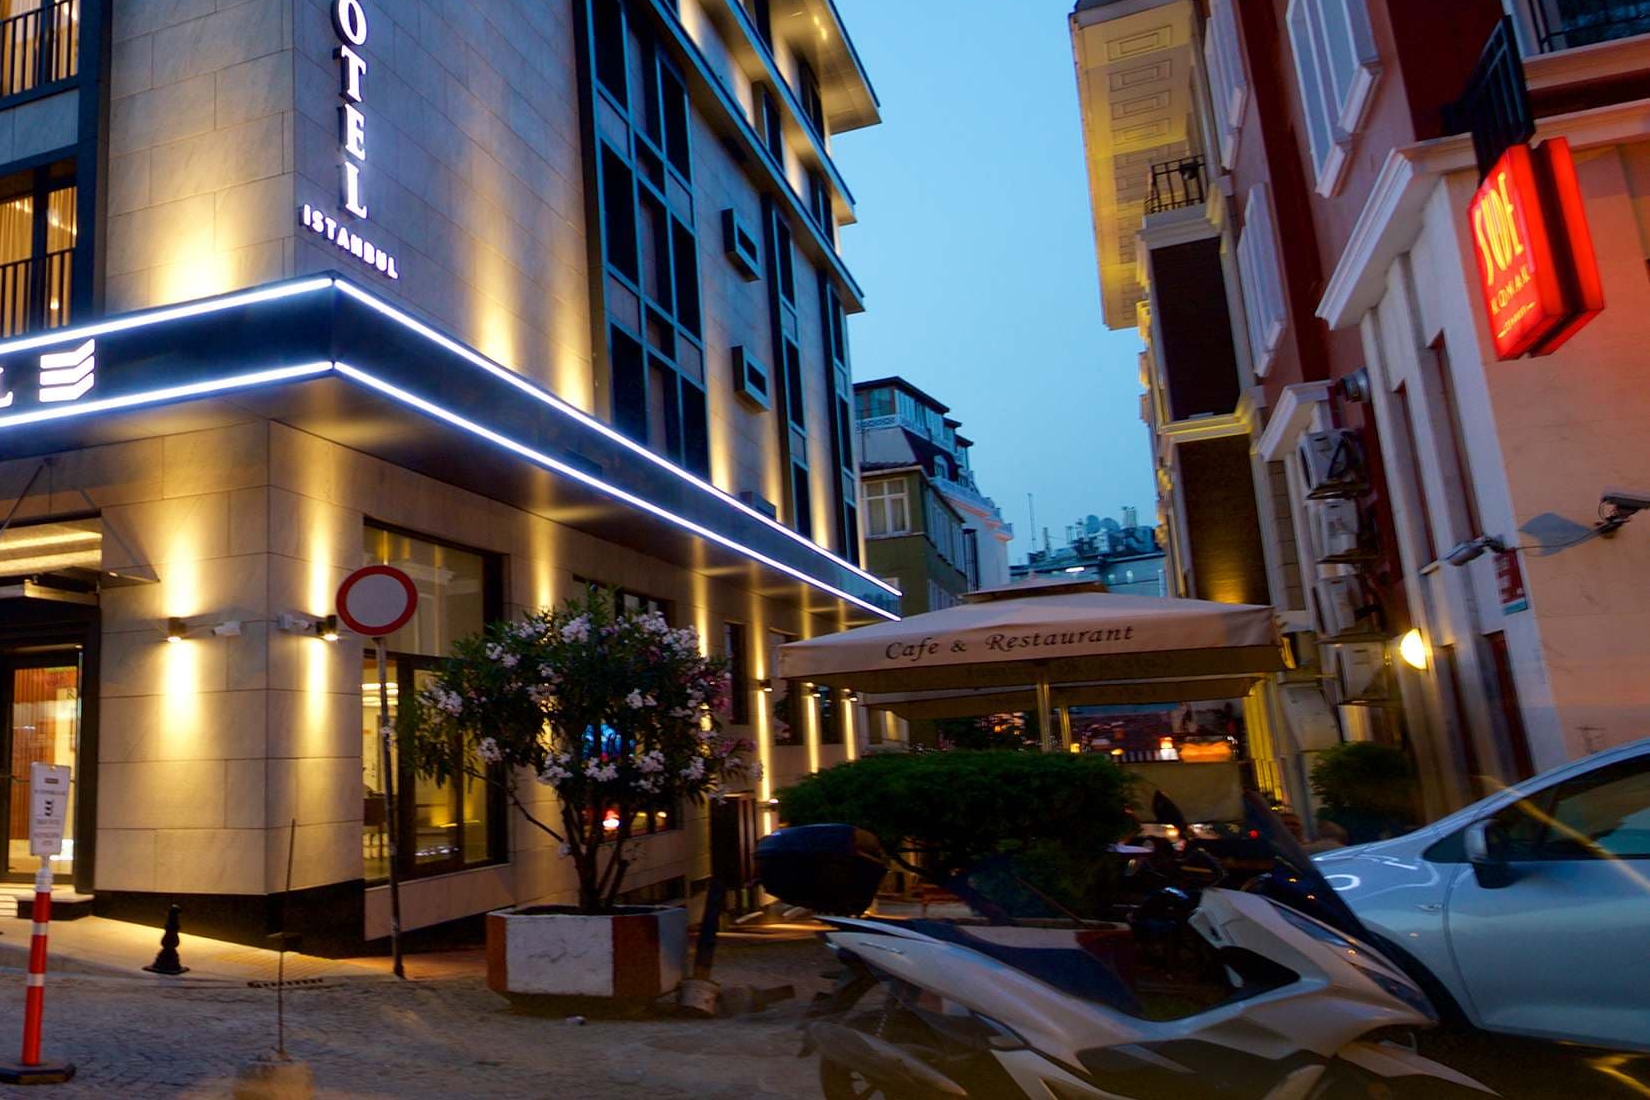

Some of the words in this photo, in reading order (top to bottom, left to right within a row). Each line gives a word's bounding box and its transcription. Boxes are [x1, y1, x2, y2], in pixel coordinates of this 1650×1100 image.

[303, 204, 399, 279] ISTANBUL
[1490, 264, 1531, 316] KONAK
[885, 636, 939, 661] Cafe
[950, 639, 966, 652] &
[985, 625, 1134, 652] Restaurant
